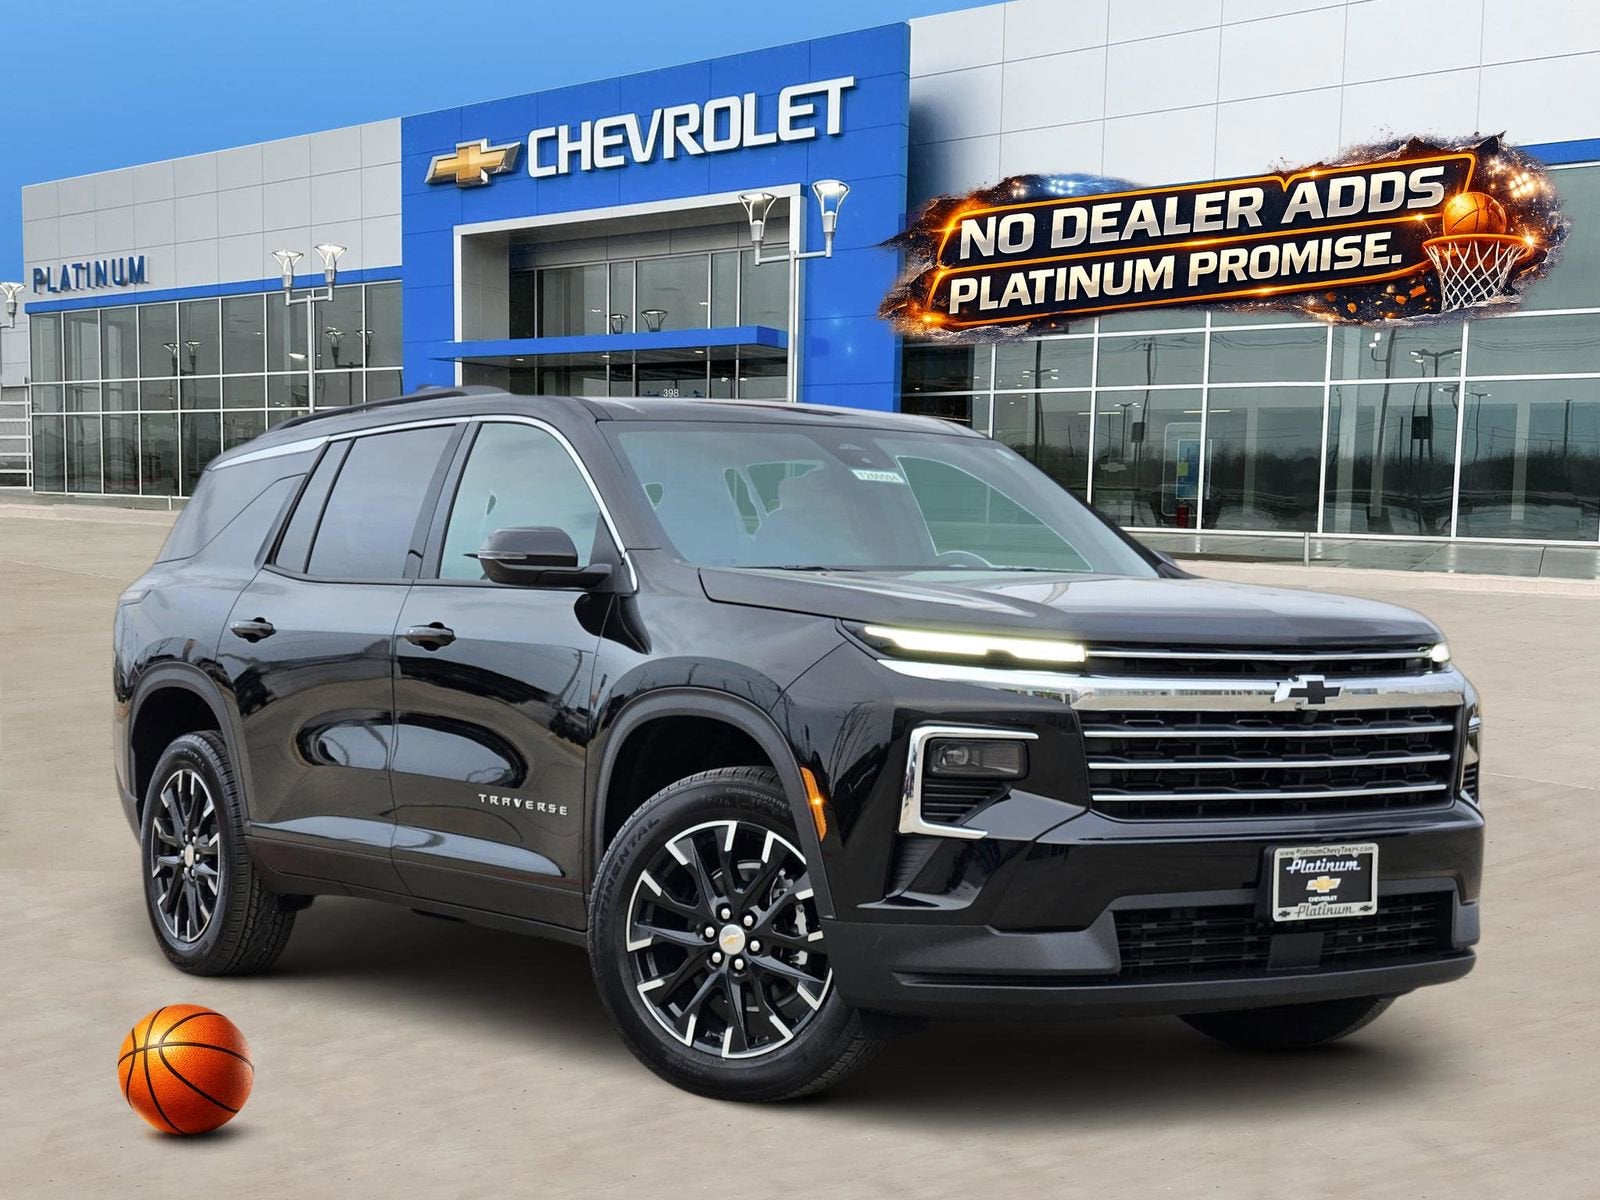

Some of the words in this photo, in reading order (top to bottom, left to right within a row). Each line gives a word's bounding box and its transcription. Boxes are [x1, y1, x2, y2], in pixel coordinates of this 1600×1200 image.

[528, 75, 855, 178] CHEVROLET
[32, 255, 146, 294] PLATINUM
[663, 388, 679, 398] 398
[478, 793, 568, 816] TRAVERSE
[1286, 858, 1361, 874] Platinum
[1295, 902, 1356, 918] Platinum
